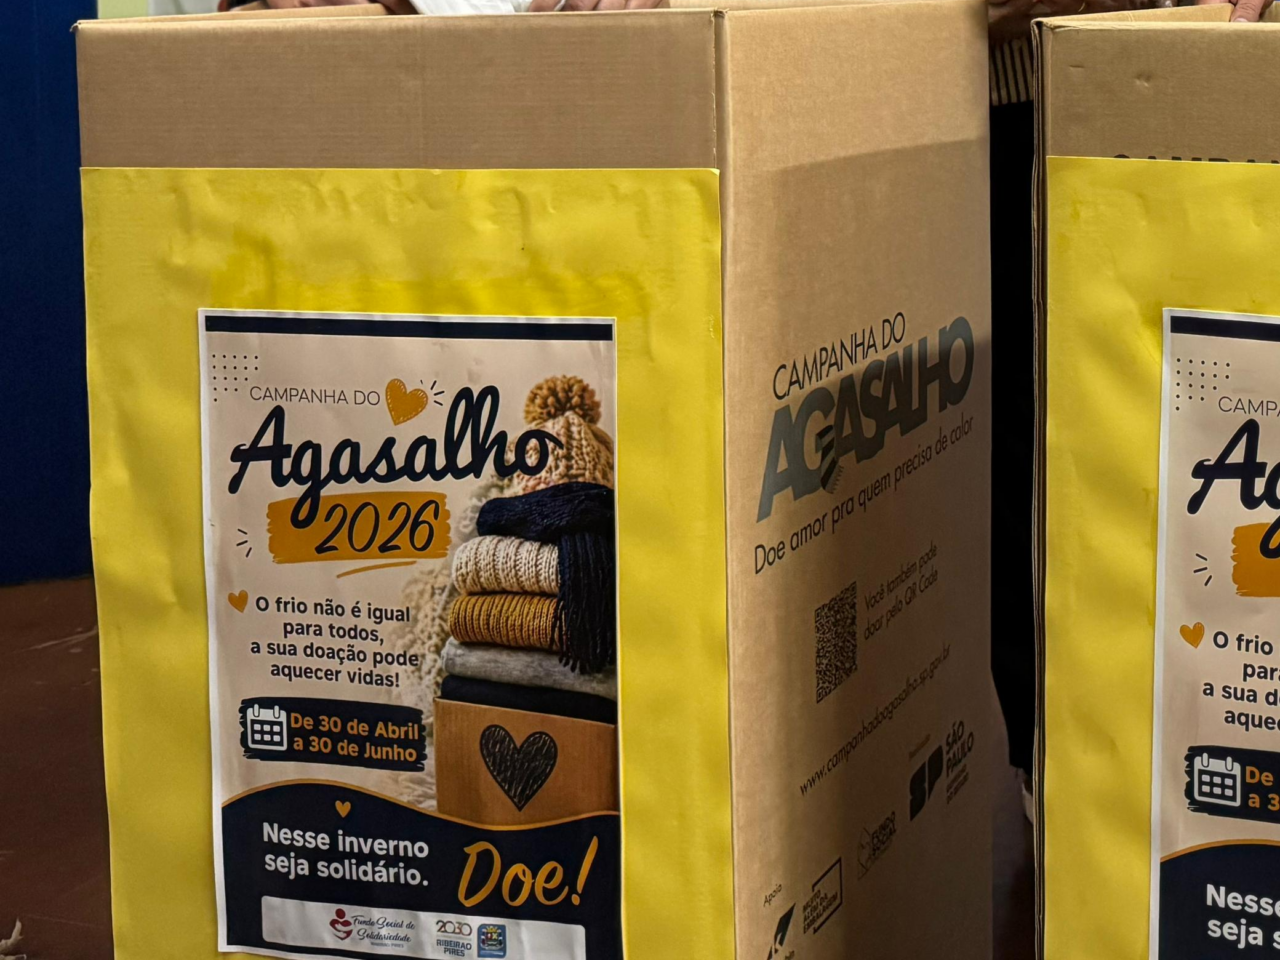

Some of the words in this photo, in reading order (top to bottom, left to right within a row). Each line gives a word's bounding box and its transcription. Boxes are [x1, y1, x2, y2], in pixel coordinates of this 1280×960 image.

[773, 325, 878, 400] CAMPANHA
[882, 312, 906, 350] DO
[250, 386, 348, 405] CAMPANHA
[354, 390, 380, 406] DO
[756, 316, 974, 523] AGASALHO
[228, 385, 564, 529] Agasalho
[755, 540, 786, 575] Doe
[790, 512, 830, 552] amor
[832, 497, 855, 534] pra
[858, 471, 891, 512] quem
[894, 445, 932, 490] precisa
[935, 427, 948, 456] de
[950, 412, 974, 445] calor
[315, 499, 440, 555] 2026
[864, 583, 885, 611] Você
[905, 582, 917, 605] QR
[255, 596, 269, 611] O
[275, 597, 308, 614] frio
[313, 599, 345, 617] não
[351, 601, 361, 617] é
[367, 603, 410, 625] igual
[283, 621, 323, 638] para
[328, 623, 384, 646] todos,
[1213, 631, 1229, 649] O
[1236, 633, 1273, 656] frio
[250, 642, 261, 654] a
[267, 643, 297, 656] sua
[303, 642, 367, 665] doação
[373, 651, 419, 668] pode
[270, 664, 341, 682] aquecer
[347, 668, 400, 687] vidas!
[1202, 681, 1214, 697] a
[1221, 683, 1258, 703] sua
[290, 712, 314, 729] De
[319, 716, 341, 732] 30
[347, 719, 369, 735] de
[375, 722, 419, 740] Abril
[293, 738, 303, 751] a
[309, 736, 332, 753] 30
[337, 740, 359, 756] de
[364, 743, 417, 762] Junho
[1245, 766, 1273, 786] De
[1248, 793, 1260, 808] a
[262, 822, 330, 850] Nesse
[338, 830, 429, 858] inverno
[264, 852, 310, 879] seja
[317, 858, 429, 886] solidário.
[457, 836, 598, 907] Doe!
[763, 884, 782, 908] Apoio
[436, 920, 472, 936] 2030
[1207, 918, 1263, 949] seja
[444, 947, 465, 957] PIRES
